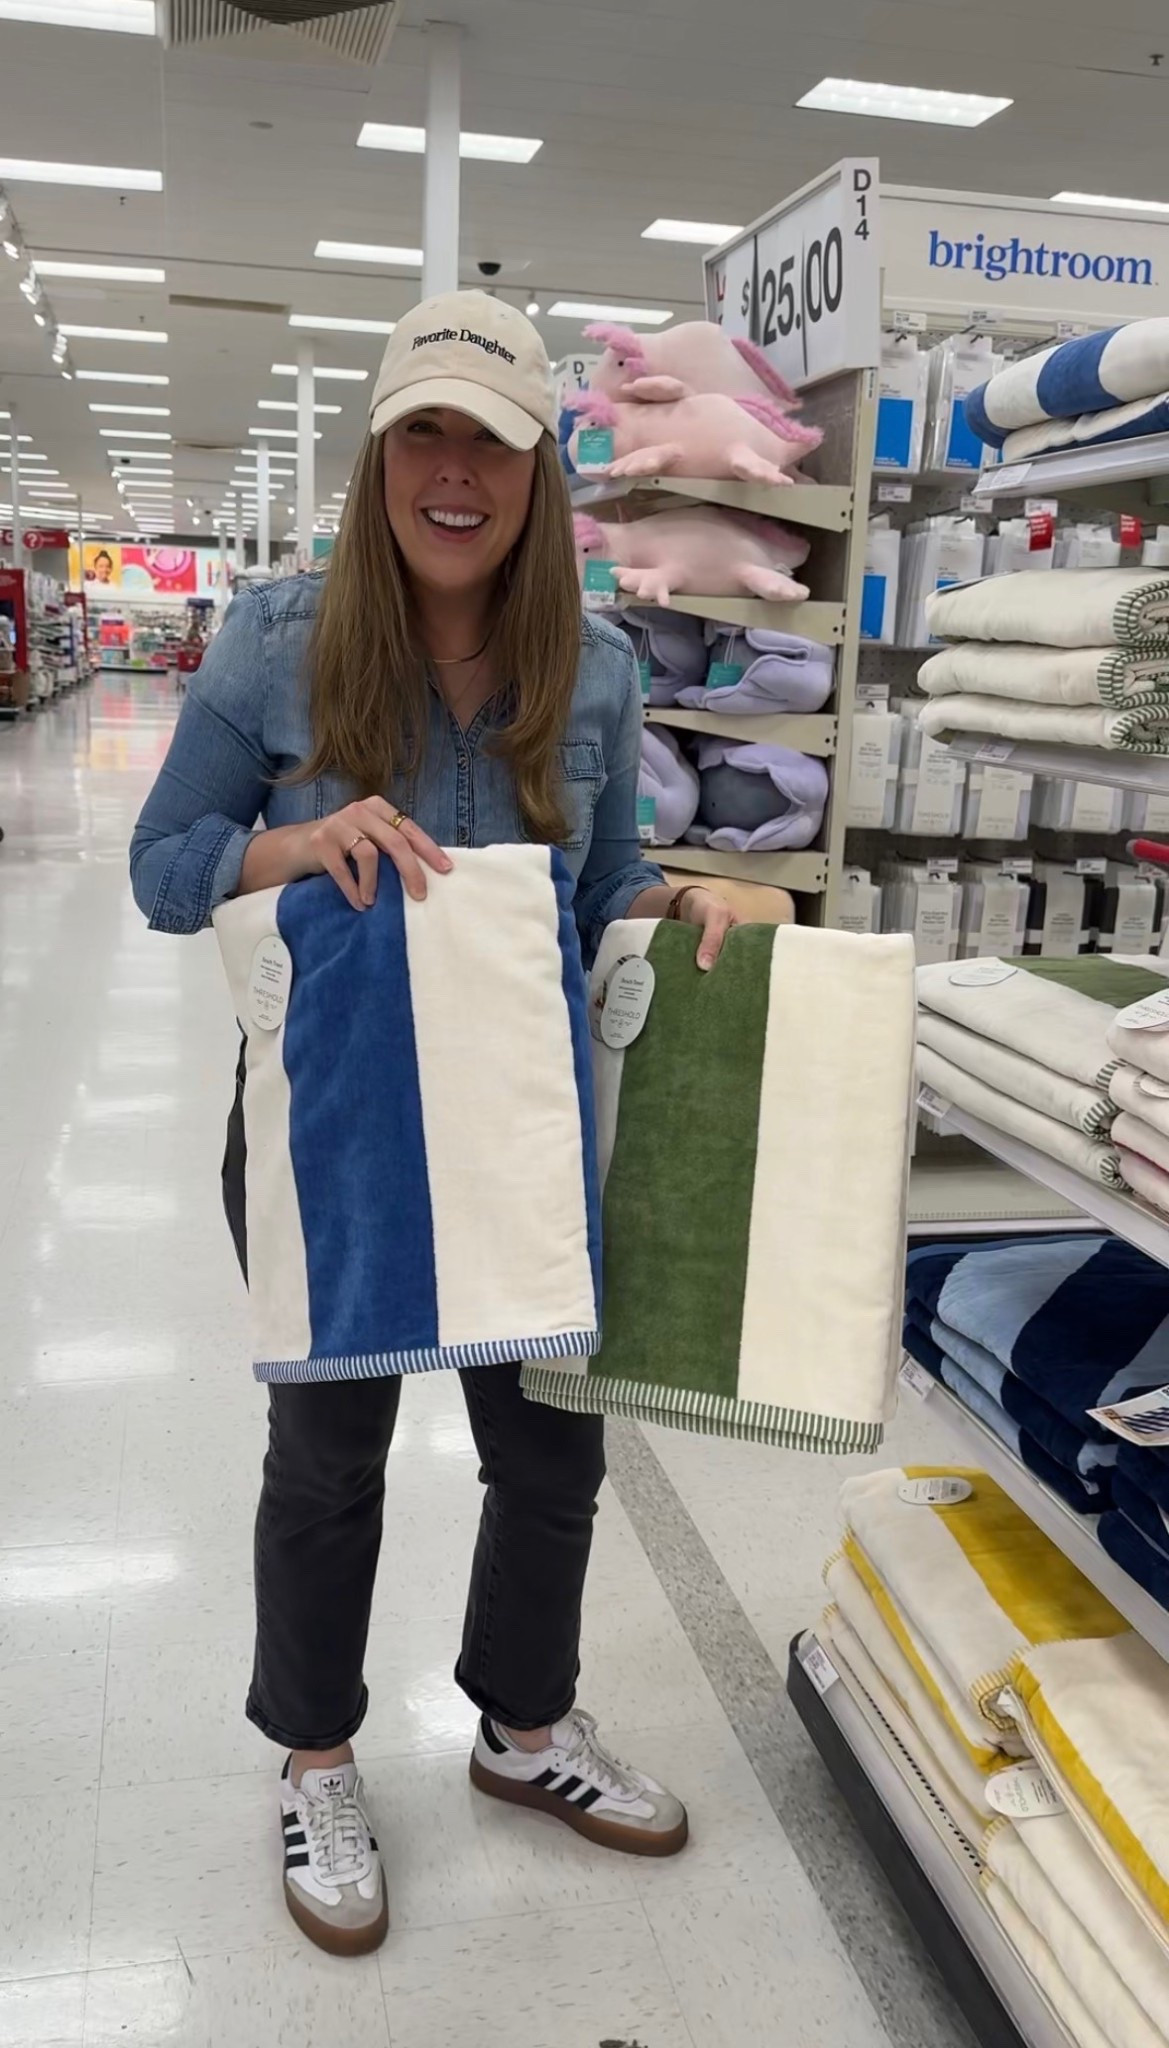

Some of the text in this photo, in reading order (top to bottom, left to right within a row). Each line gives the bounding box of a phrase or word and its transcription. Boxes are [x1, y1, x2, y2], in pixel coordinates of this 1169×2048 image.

[928, 230, 1154, 286] brightroom
[411, 328, 517, 366] Favorite Daughter
